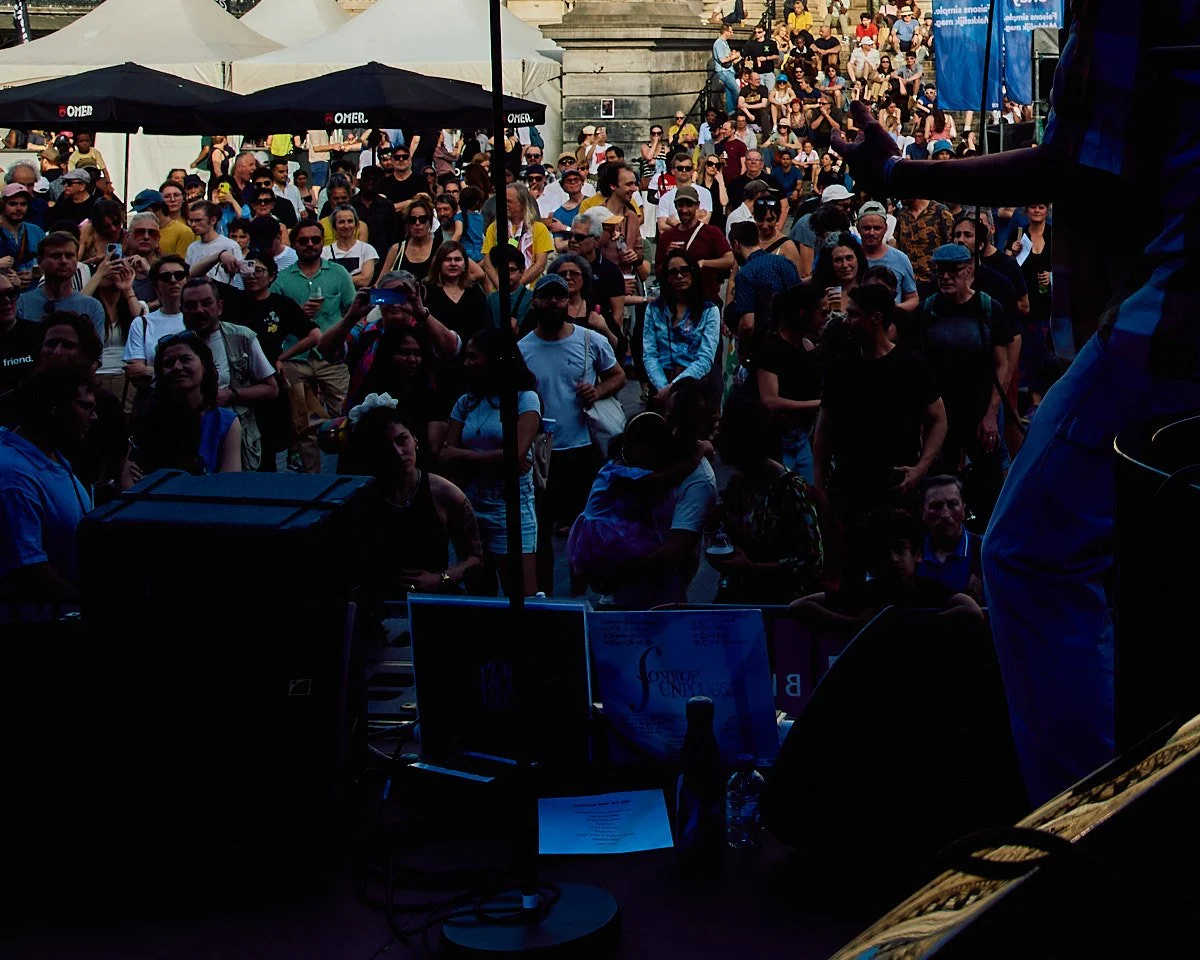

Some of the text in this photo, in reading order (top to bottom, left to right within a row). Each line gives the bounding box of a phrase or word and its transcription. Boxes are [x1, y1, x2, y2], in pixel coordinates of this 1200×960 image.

[334, 112, 369, 124] OMER.
[507, 112, 534, 124] OMER.
[3, 354, 34, 367] friend.
